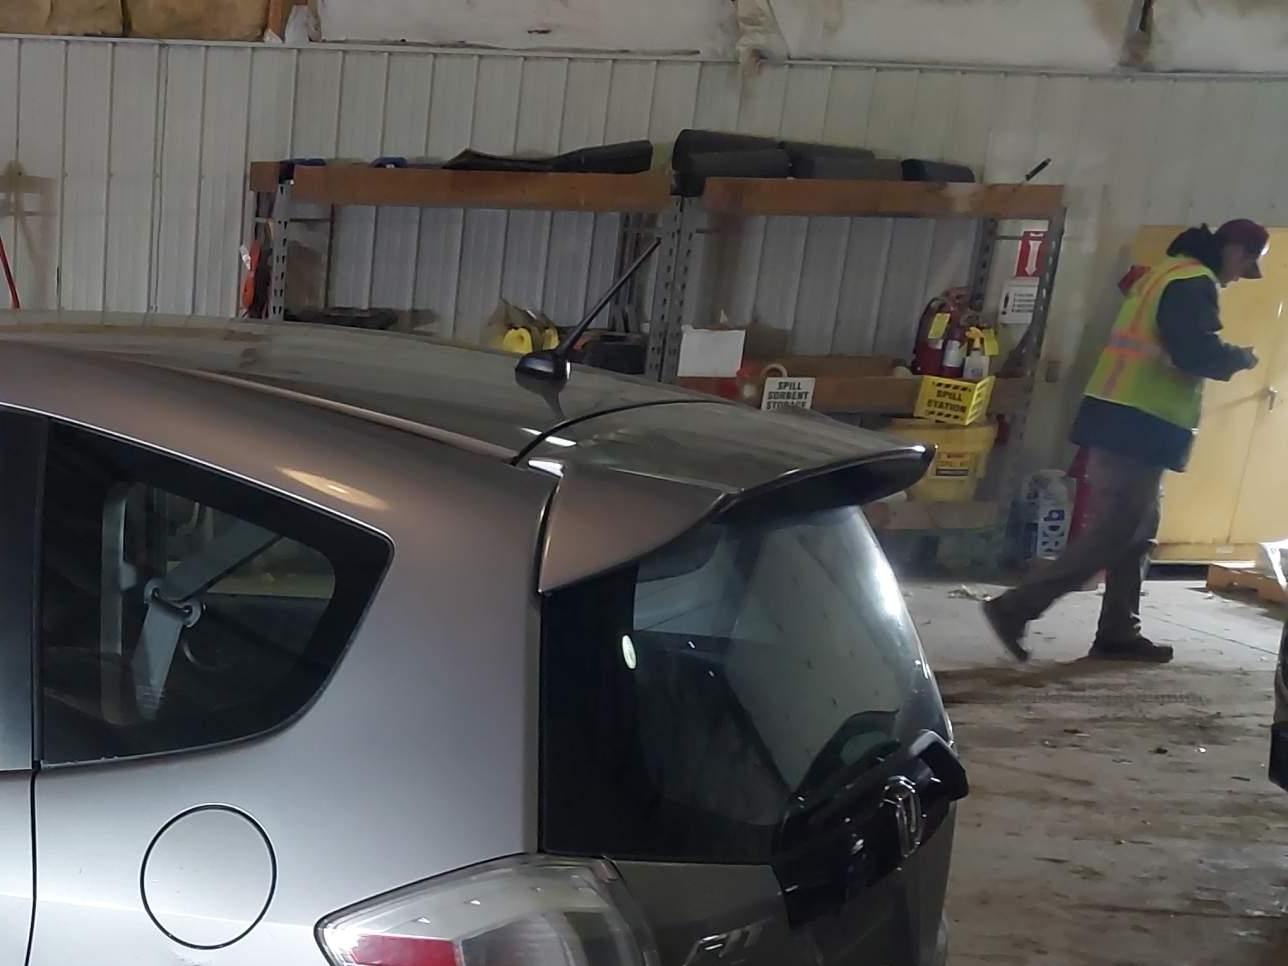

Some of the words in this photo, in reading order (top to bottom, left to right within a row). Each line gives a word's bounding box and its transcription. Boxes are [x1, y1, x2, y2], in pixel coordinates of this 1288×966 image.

[778, 381, 801, 390] SPILL
[768, 391, 809, 400] SORBENT
[937, 390, 963, 402] SPILL
[927, 399, 968, 413] STATION
